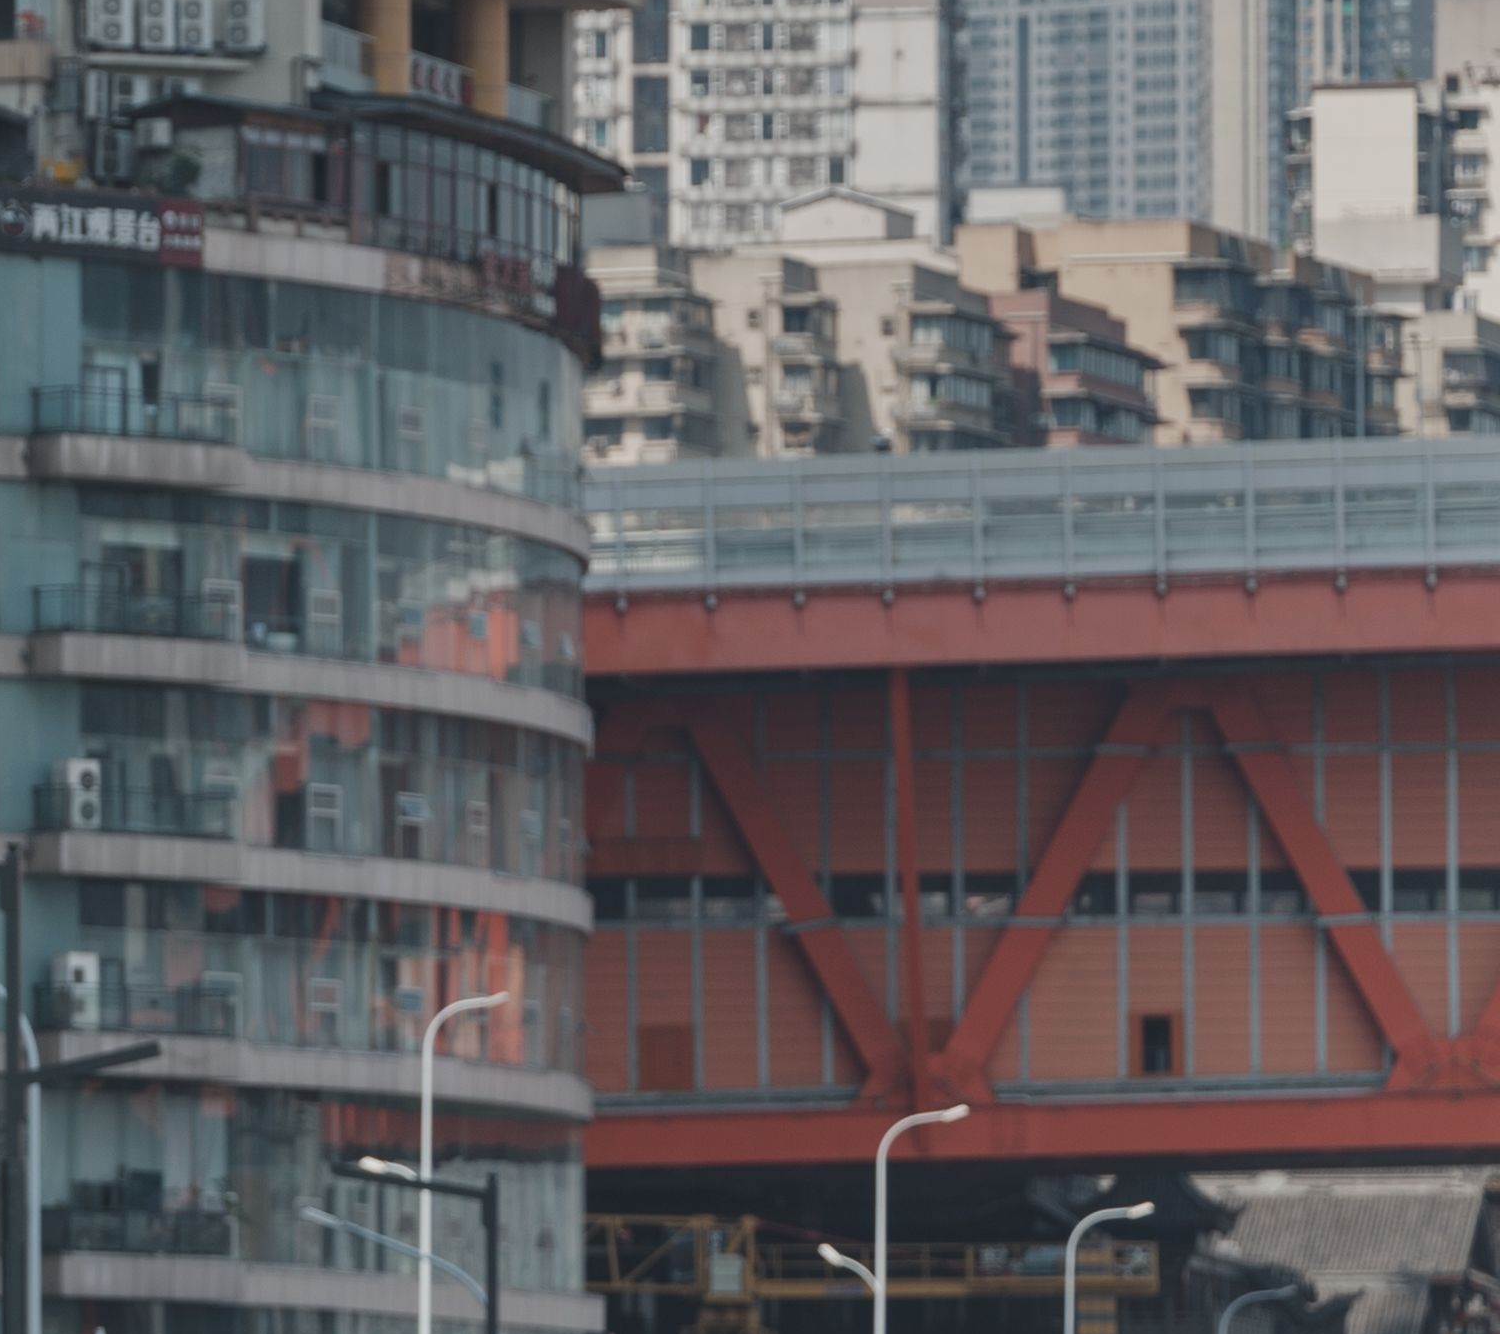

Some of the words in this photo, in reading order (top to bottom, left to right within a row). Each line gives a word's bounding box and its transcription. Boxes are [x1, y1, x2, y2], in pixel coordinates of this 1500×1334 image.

[32, 203, 161, 252] 两江观景台
